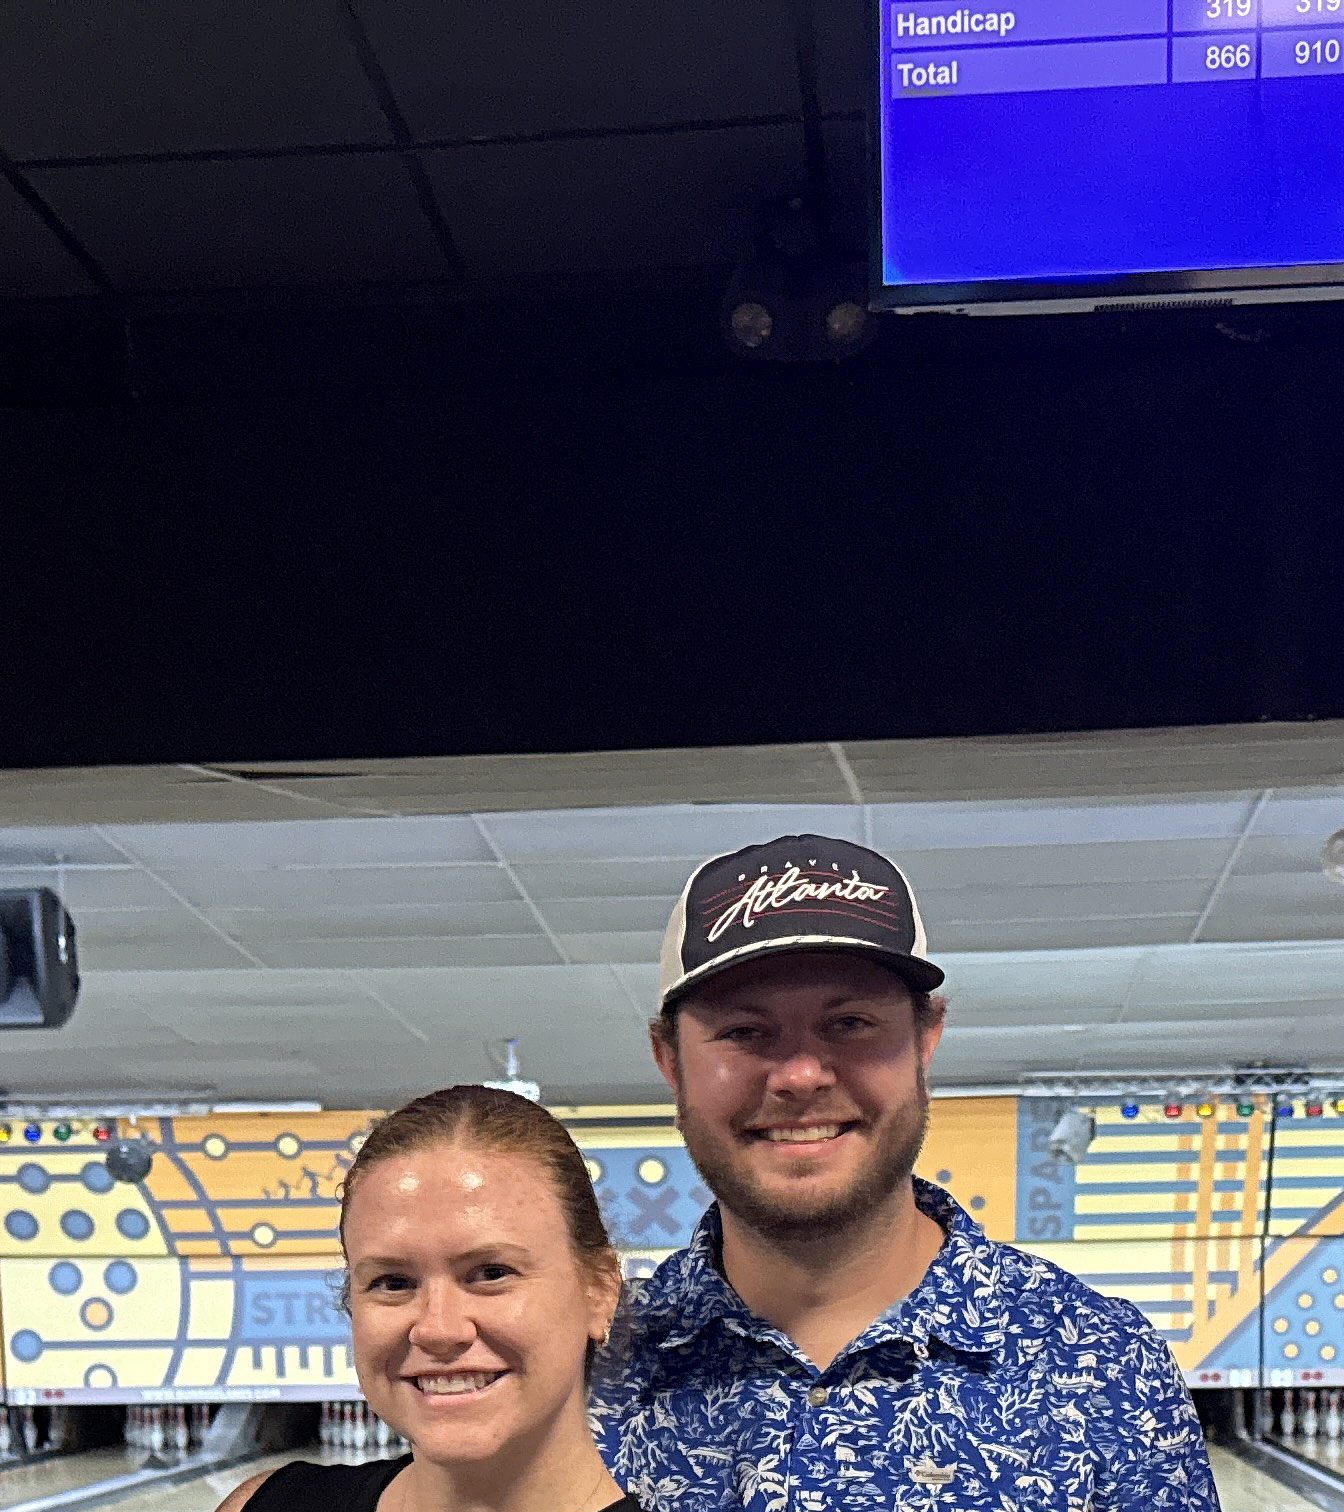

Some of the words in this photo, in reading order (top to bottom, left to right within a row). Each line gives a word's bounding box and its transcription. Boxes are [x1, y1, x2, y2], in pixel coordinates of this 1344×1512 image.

[896, 8, 1016, 38] Handicap
[896, 61, 958, 88] Total
[1206, 45, 1252, 70] 866
[1294, 40, 1341, 65] 910
[707, 867, 889, 942] Atlanta
